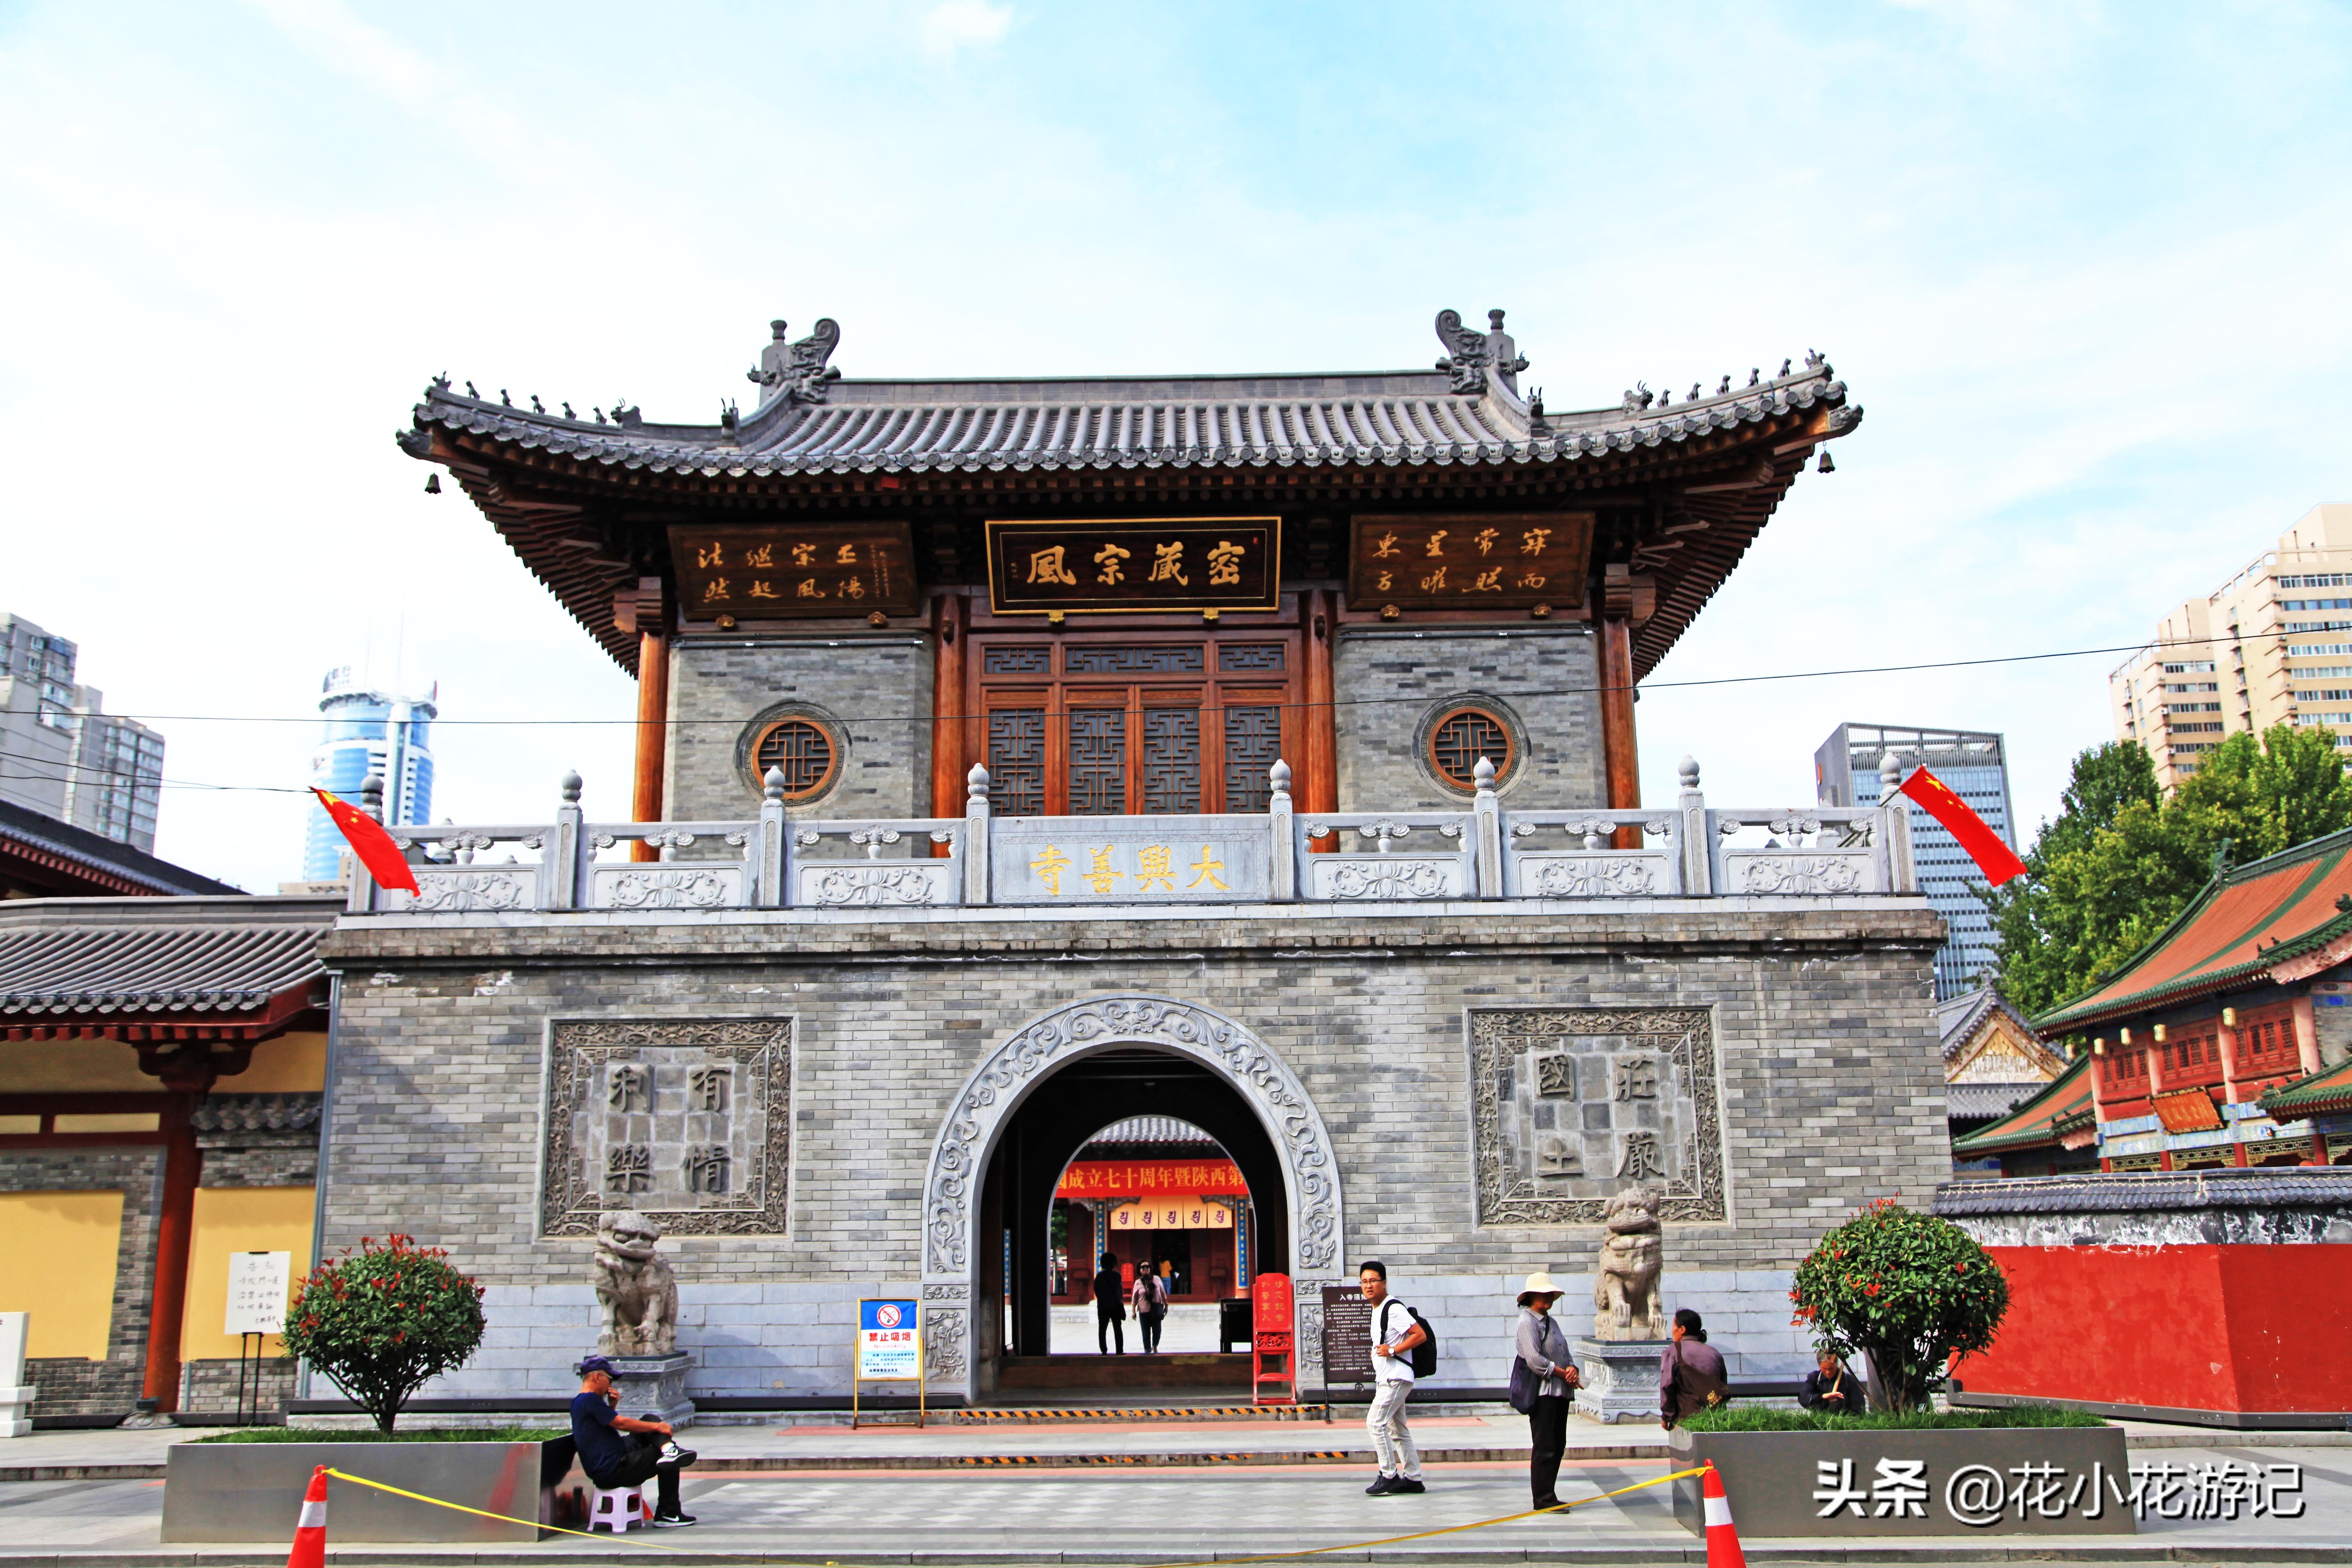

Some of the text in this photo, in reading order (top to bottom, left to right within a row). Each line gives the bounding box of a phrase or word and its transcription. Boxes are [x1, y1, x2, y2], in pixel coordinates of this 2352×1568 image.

[1029, 843, 1231, 896] 大興善寺
[869, 1332, 910, 1342] 禁止吸烟
